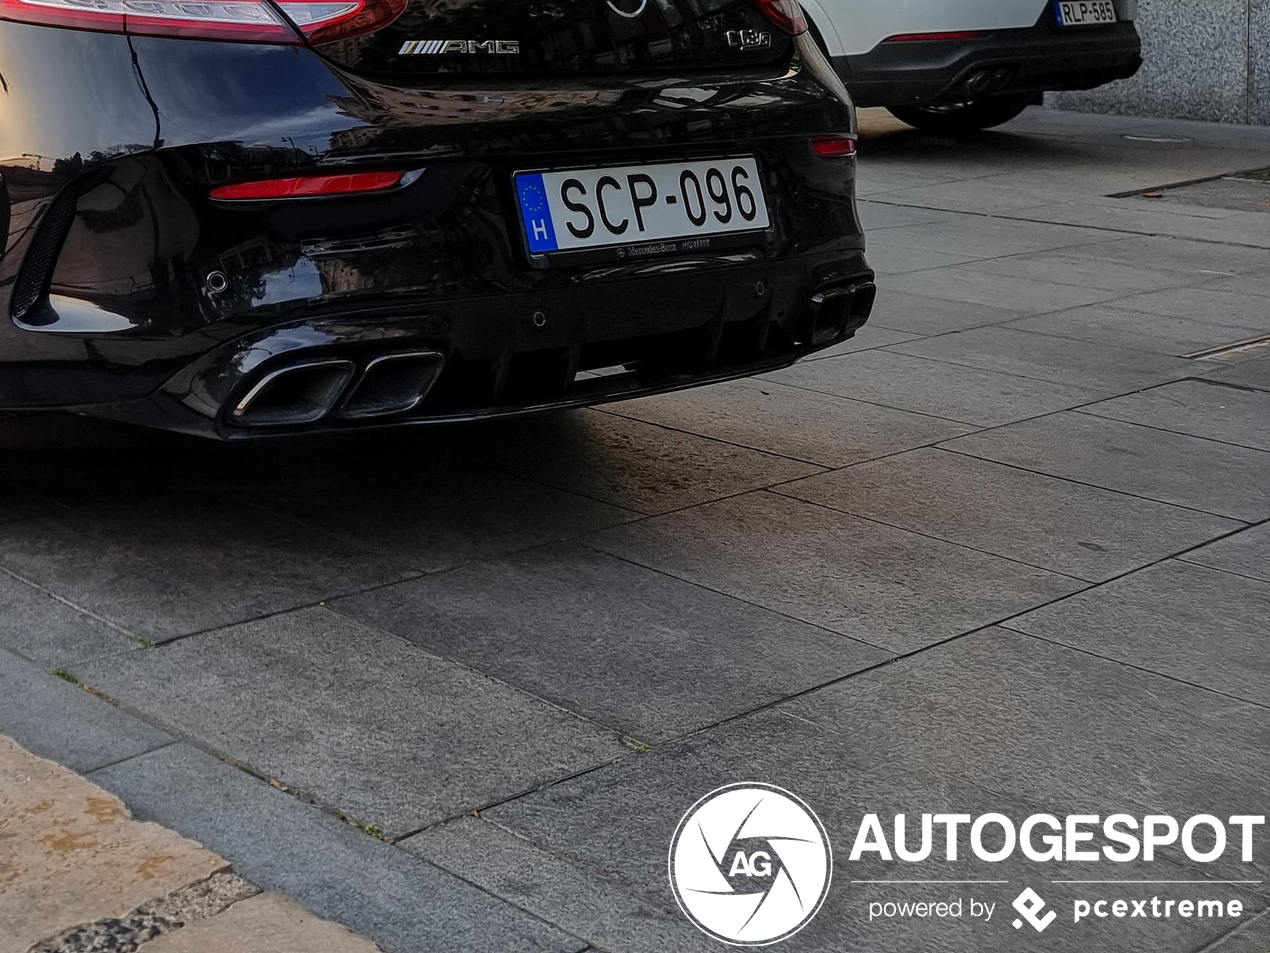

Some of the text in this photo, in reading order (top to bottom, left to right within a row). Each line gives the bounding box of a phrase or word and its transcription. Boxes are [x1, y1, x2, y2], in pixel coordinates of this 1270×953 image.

[1061, 1, 1114, 23] RLP-585
[439, 40, 520, 54] AMG
[560, 165, 757, 239] SCP-096
[532, 218, 549, 241] H
